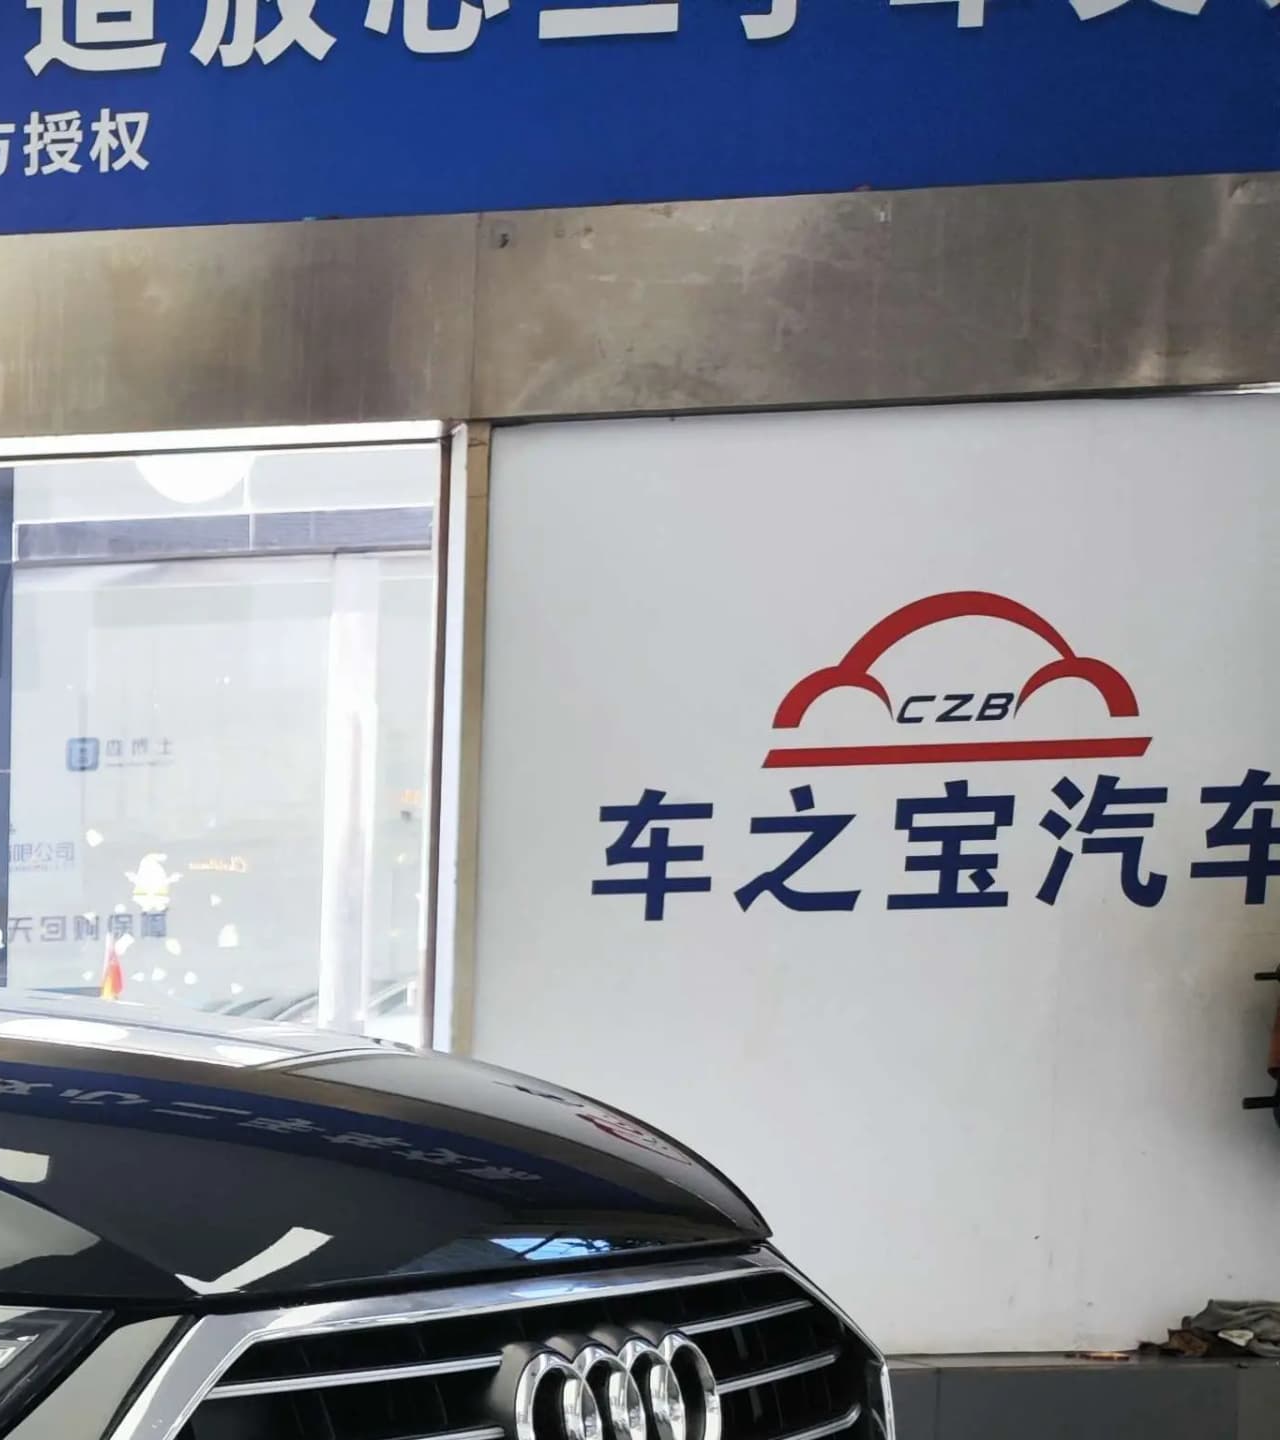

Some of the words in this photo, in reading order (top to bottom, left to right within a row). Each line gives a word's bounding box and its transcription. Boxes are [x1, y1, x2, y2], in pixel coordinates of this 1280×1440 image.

[896, 691, 1015, 724] CZB
[591, 768, 1280, 922] 车之宝汽车
